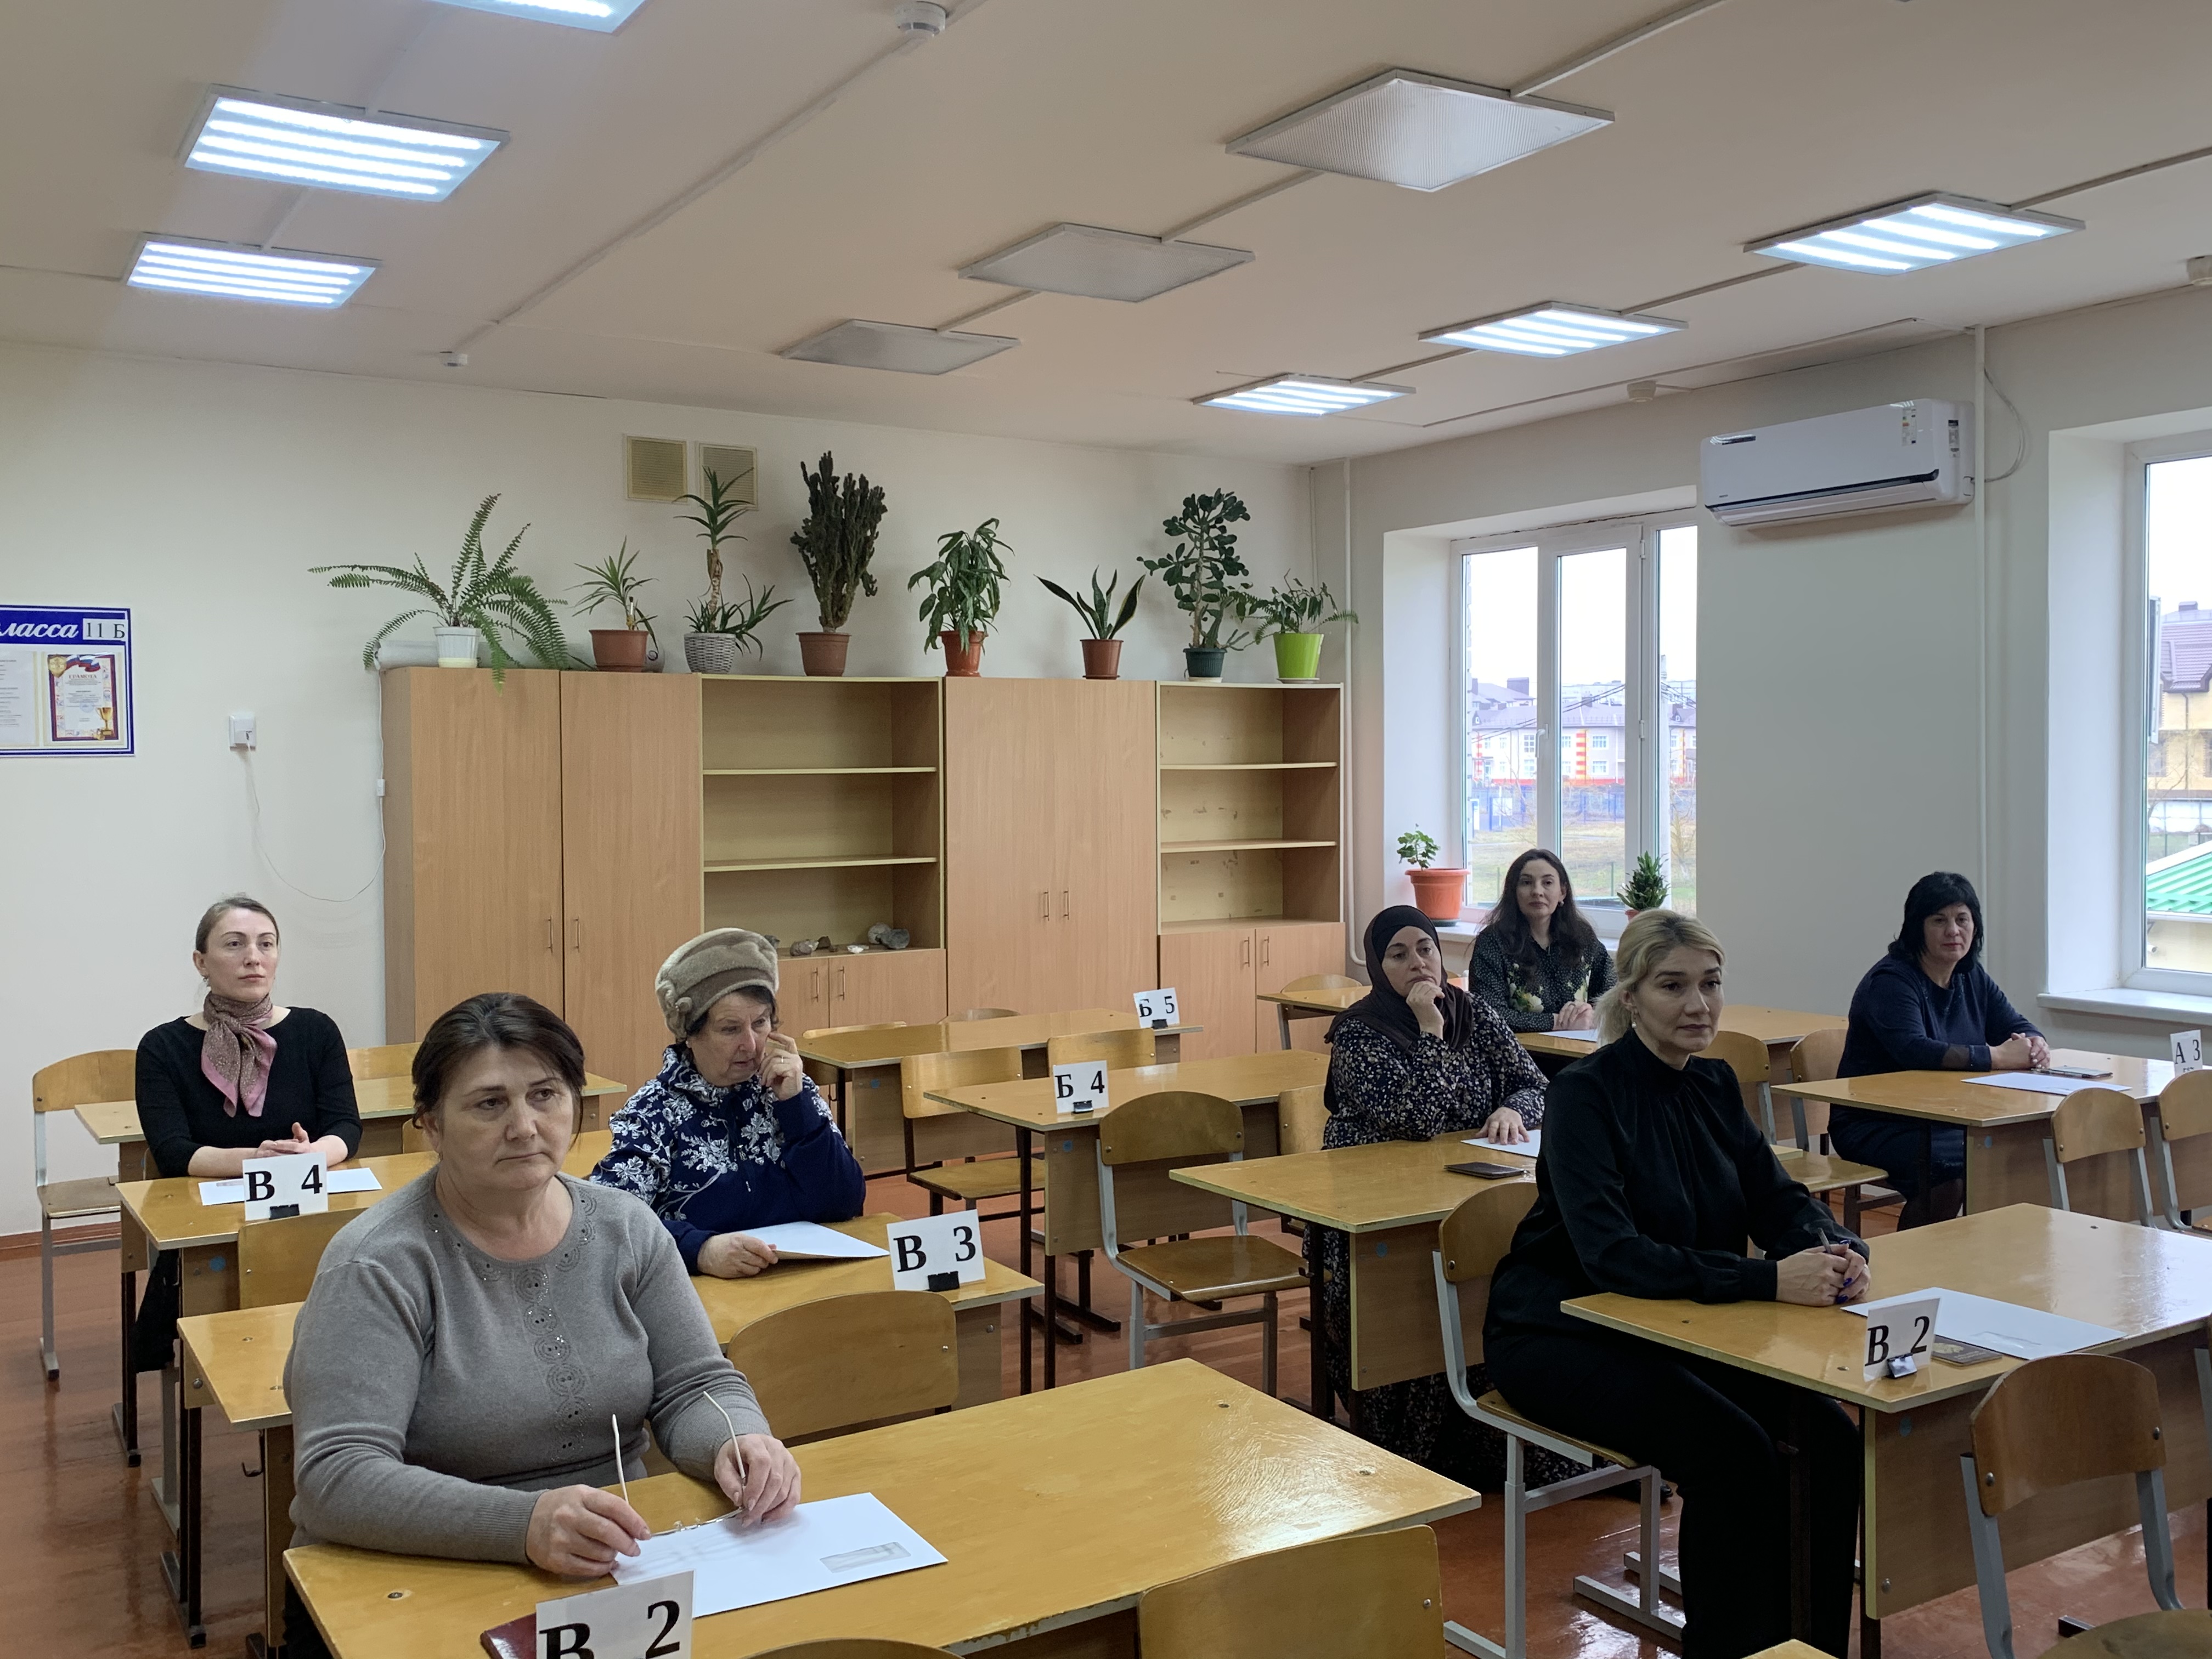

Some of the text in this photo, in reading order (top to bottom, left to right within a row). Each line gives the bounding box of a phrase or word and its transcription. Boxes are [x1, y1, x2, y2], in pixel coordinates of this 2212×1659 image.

[0, 622, 125, 639] ласса 11 Б
[1139, 996, 1175, 1017] Б 5
[2175, 1039, 2200, 1064] А 3
[1054, 1070, 1105, 1099] Б 4
[245, 1164, 323, 1201] В 4
[893, 1226, 976, 1272] В 3
[1864, 1316, 1930, 1367] В 2
[645, 1600, 680, 1659] 2
